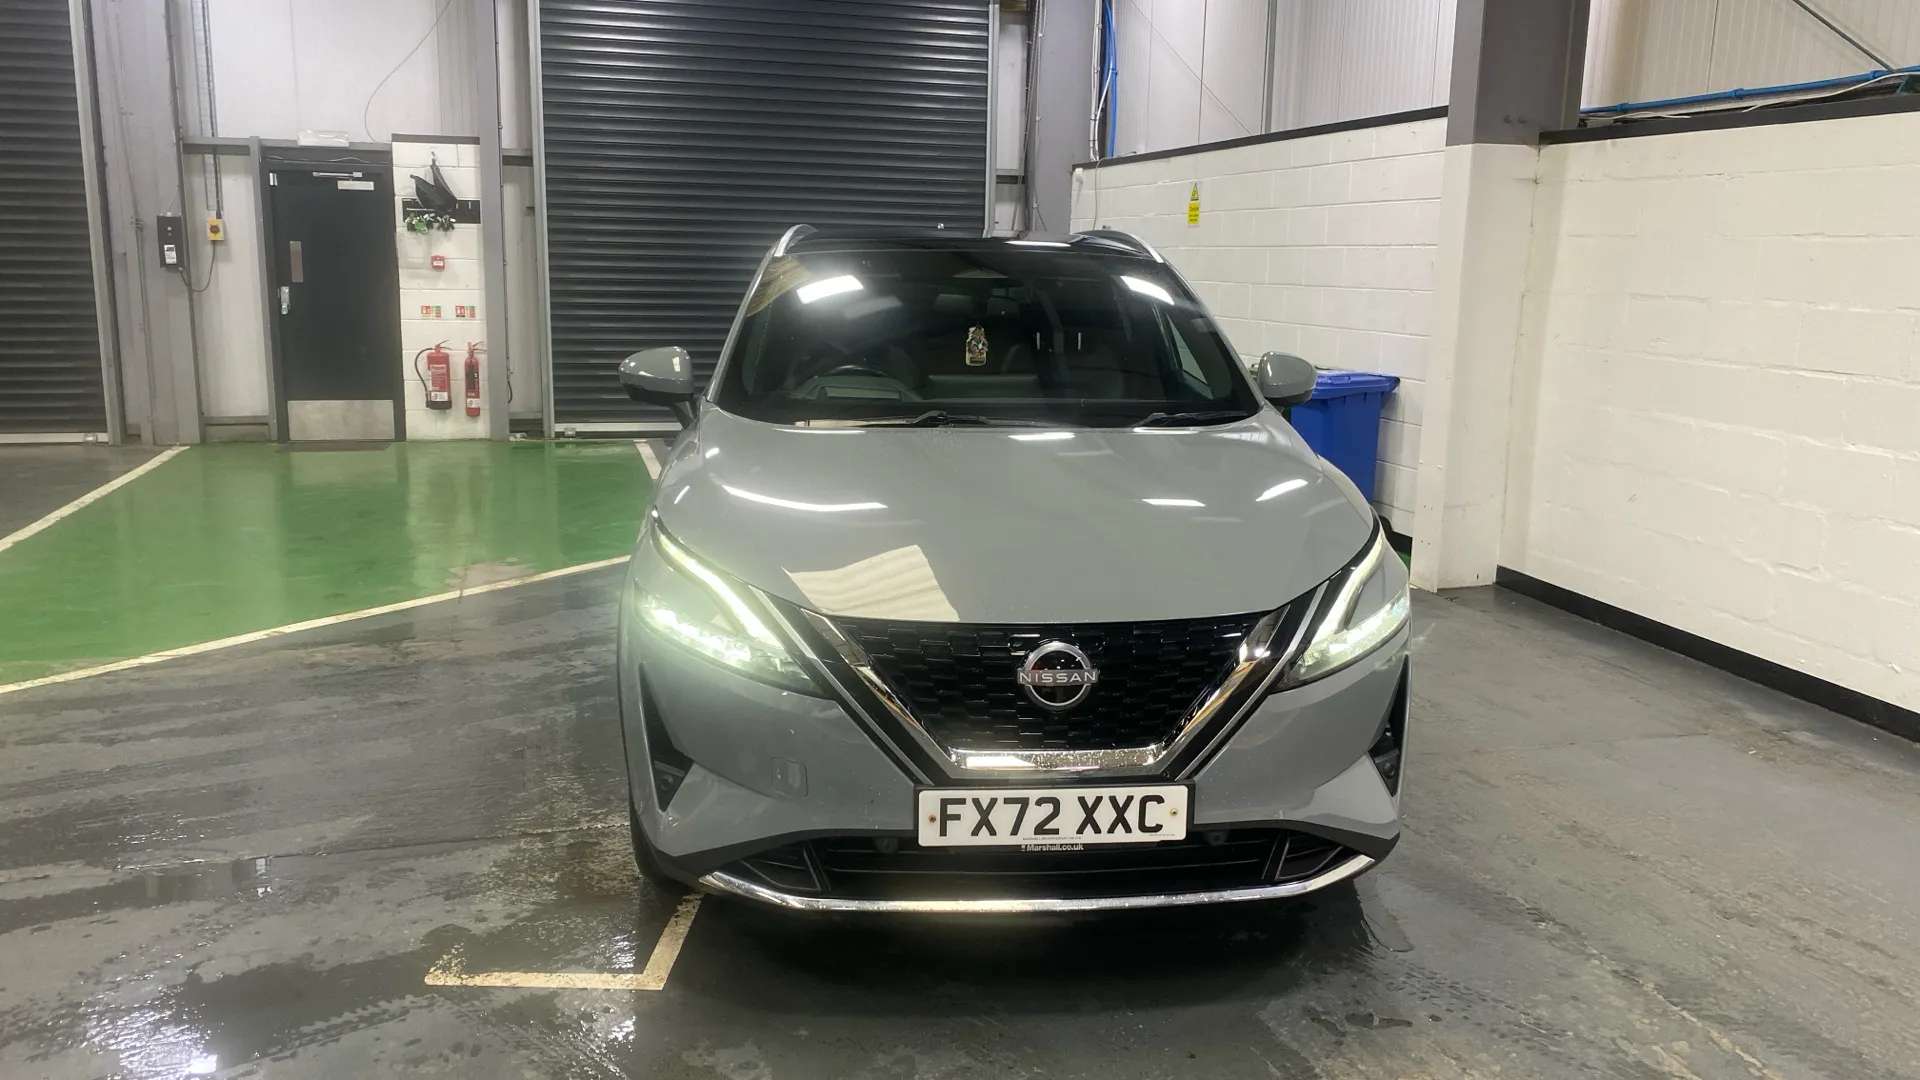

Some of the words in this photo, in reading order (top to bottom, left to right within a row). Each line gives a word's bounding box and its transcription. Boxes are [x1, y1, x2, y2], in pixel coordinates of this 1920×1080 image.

[1019, 671, 1096, 683] NISSAN
[938, 797, 1061, 838] FX72
[1075, 794, 1166, 835] XXC
